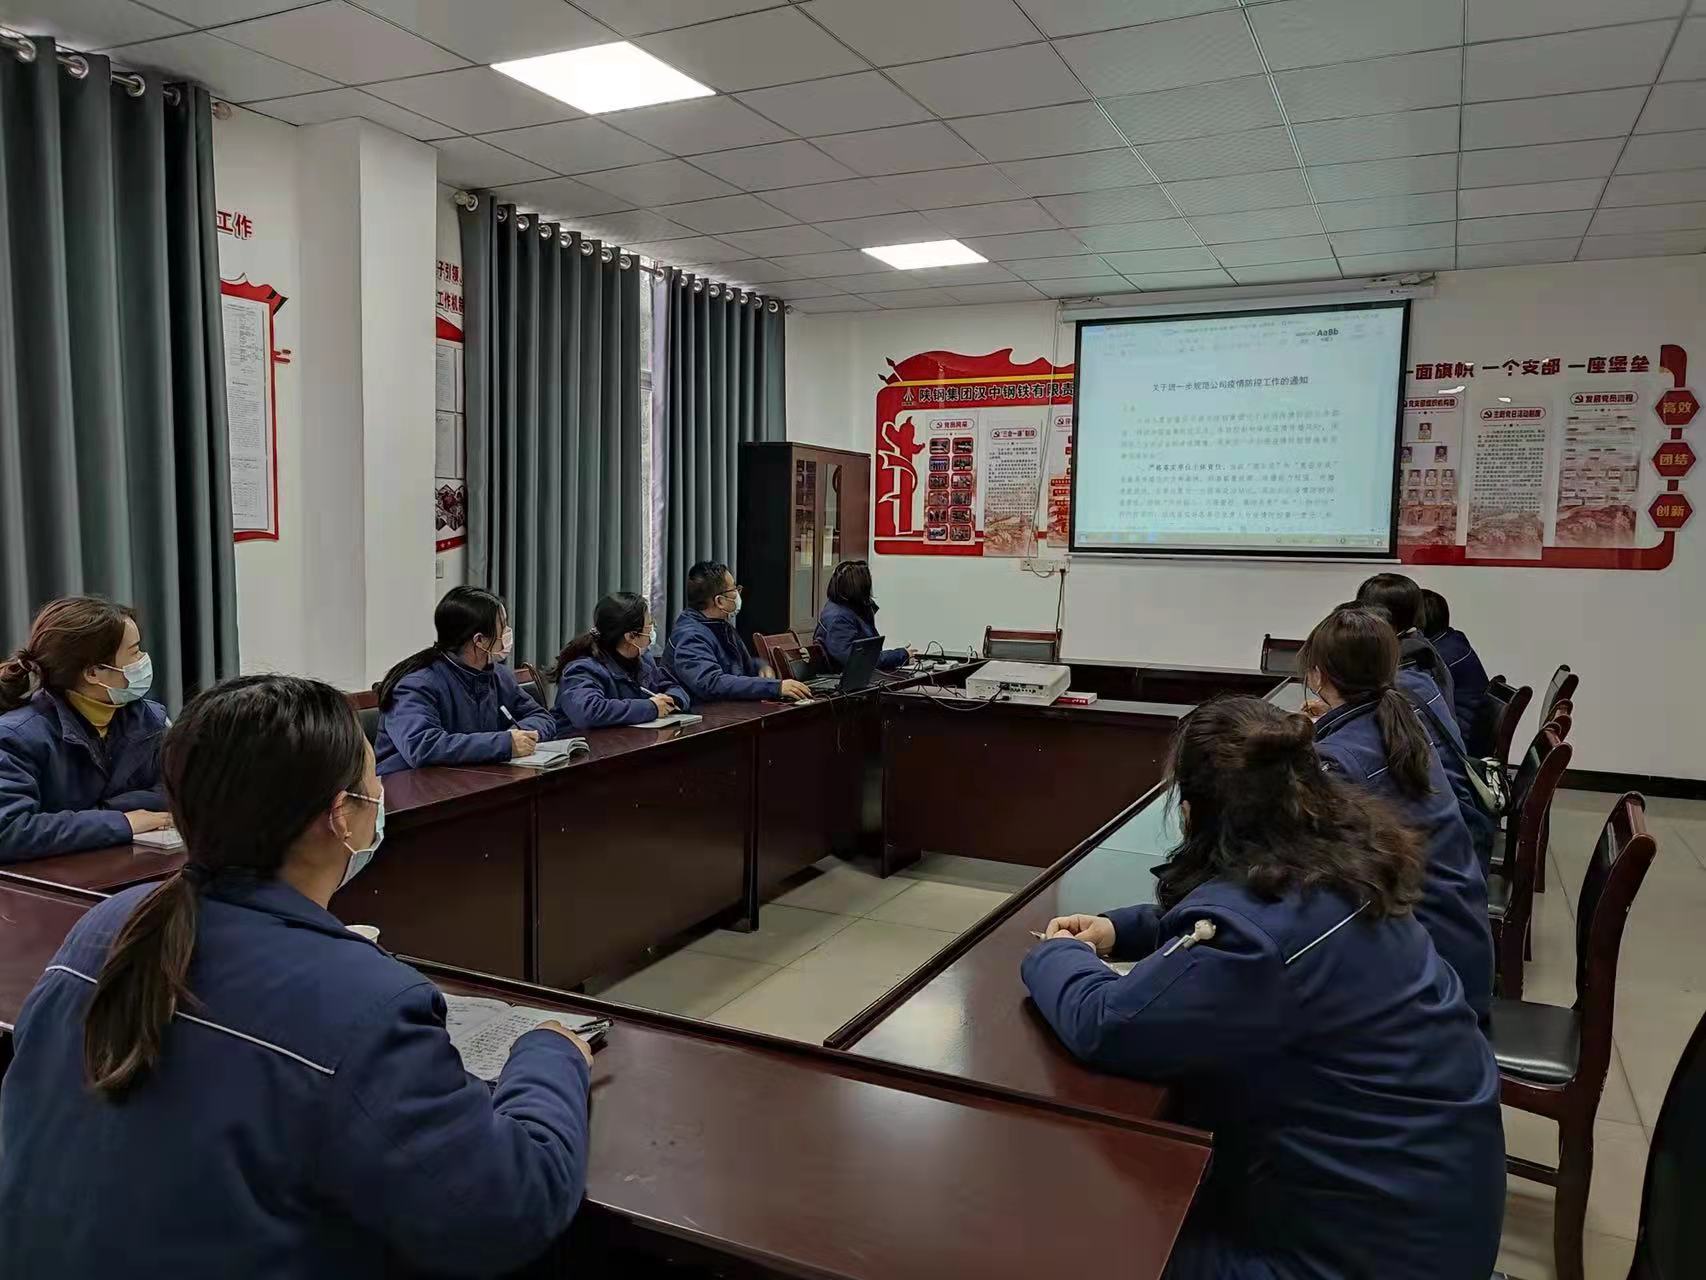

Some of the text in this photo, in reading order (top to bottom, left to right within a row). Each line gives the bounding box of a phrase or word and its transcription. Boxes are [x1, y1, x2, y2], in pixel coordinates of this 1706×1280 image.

[216, 210, 253, 238] 工作
[1316, 327, 1339, 336] AaBb
[1482, 357, 1561, 377] 一个支部
[1567, 354, 1651, 374] 一座堡垒
[918, 382, 1074, 403] 陕钢集团汉中钢铁有限责
[1663, 401, 1692, 414] 高效
[1659, 453, 1689, 466] 团结
[1656, 504, 1685, 517] 创新
